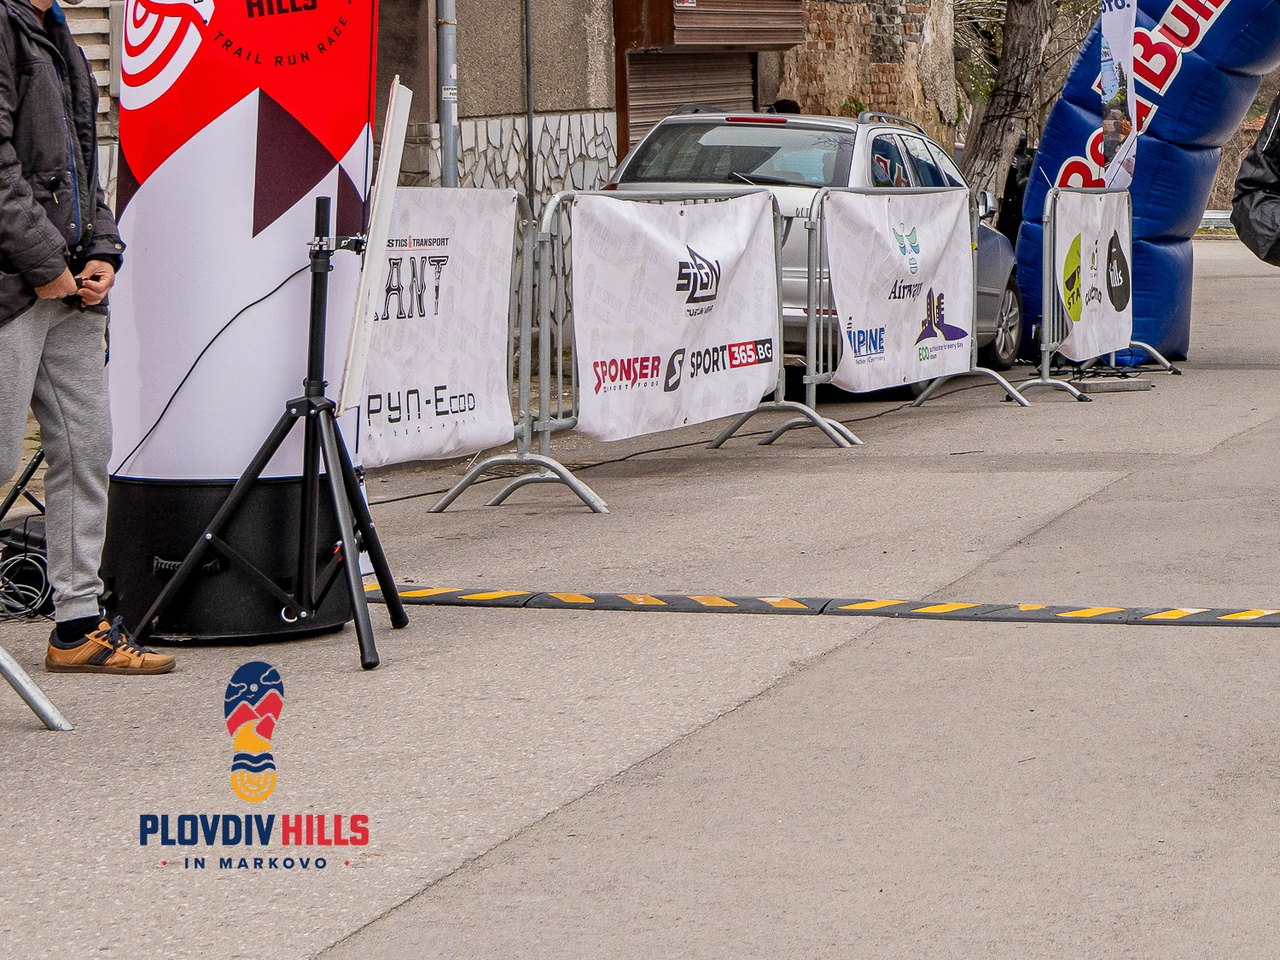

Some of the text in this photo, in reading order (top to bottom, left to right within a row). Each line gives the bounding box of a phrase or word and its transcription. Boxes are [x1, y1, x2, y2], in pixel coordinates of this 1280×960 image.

[213, 16, 347, 67] TRAIL RUN RACE
[387, 237, 449, 248] STICS TRANSPORT
[376, 255, 449, 321] ANT
[593, 356, 661, 395] SPONSER
